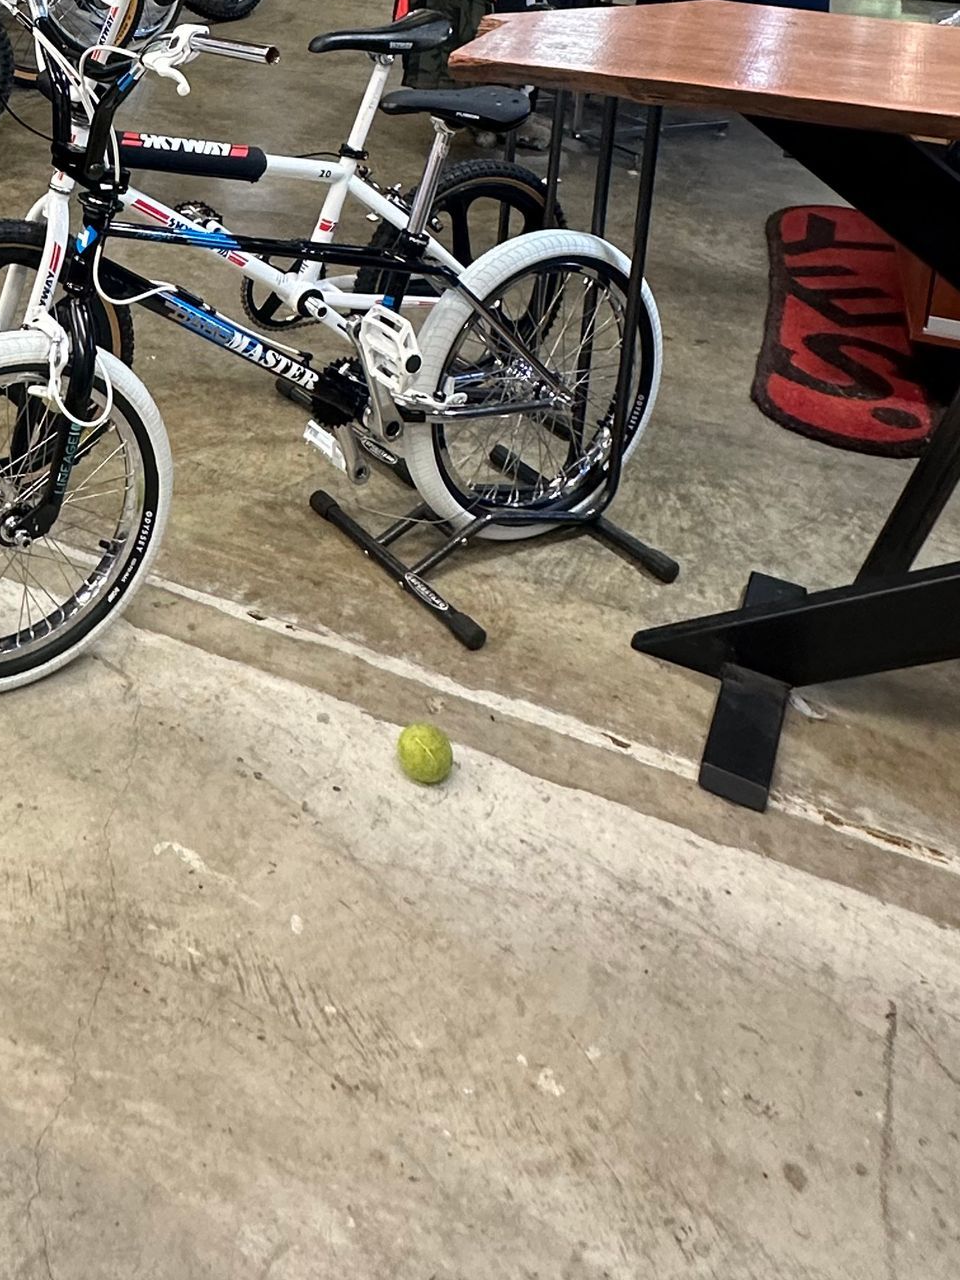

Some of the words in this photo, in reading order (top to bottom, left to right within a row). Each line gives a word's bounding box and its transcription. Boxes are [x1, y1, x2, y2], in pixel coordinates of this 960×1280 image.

[140, 133, 231, 157] SKYWAY
[319, 169, 331, 179] 20
[224, 330, 320, 391] MASTER
[136, 510, 153, 553] ODYSSEY
